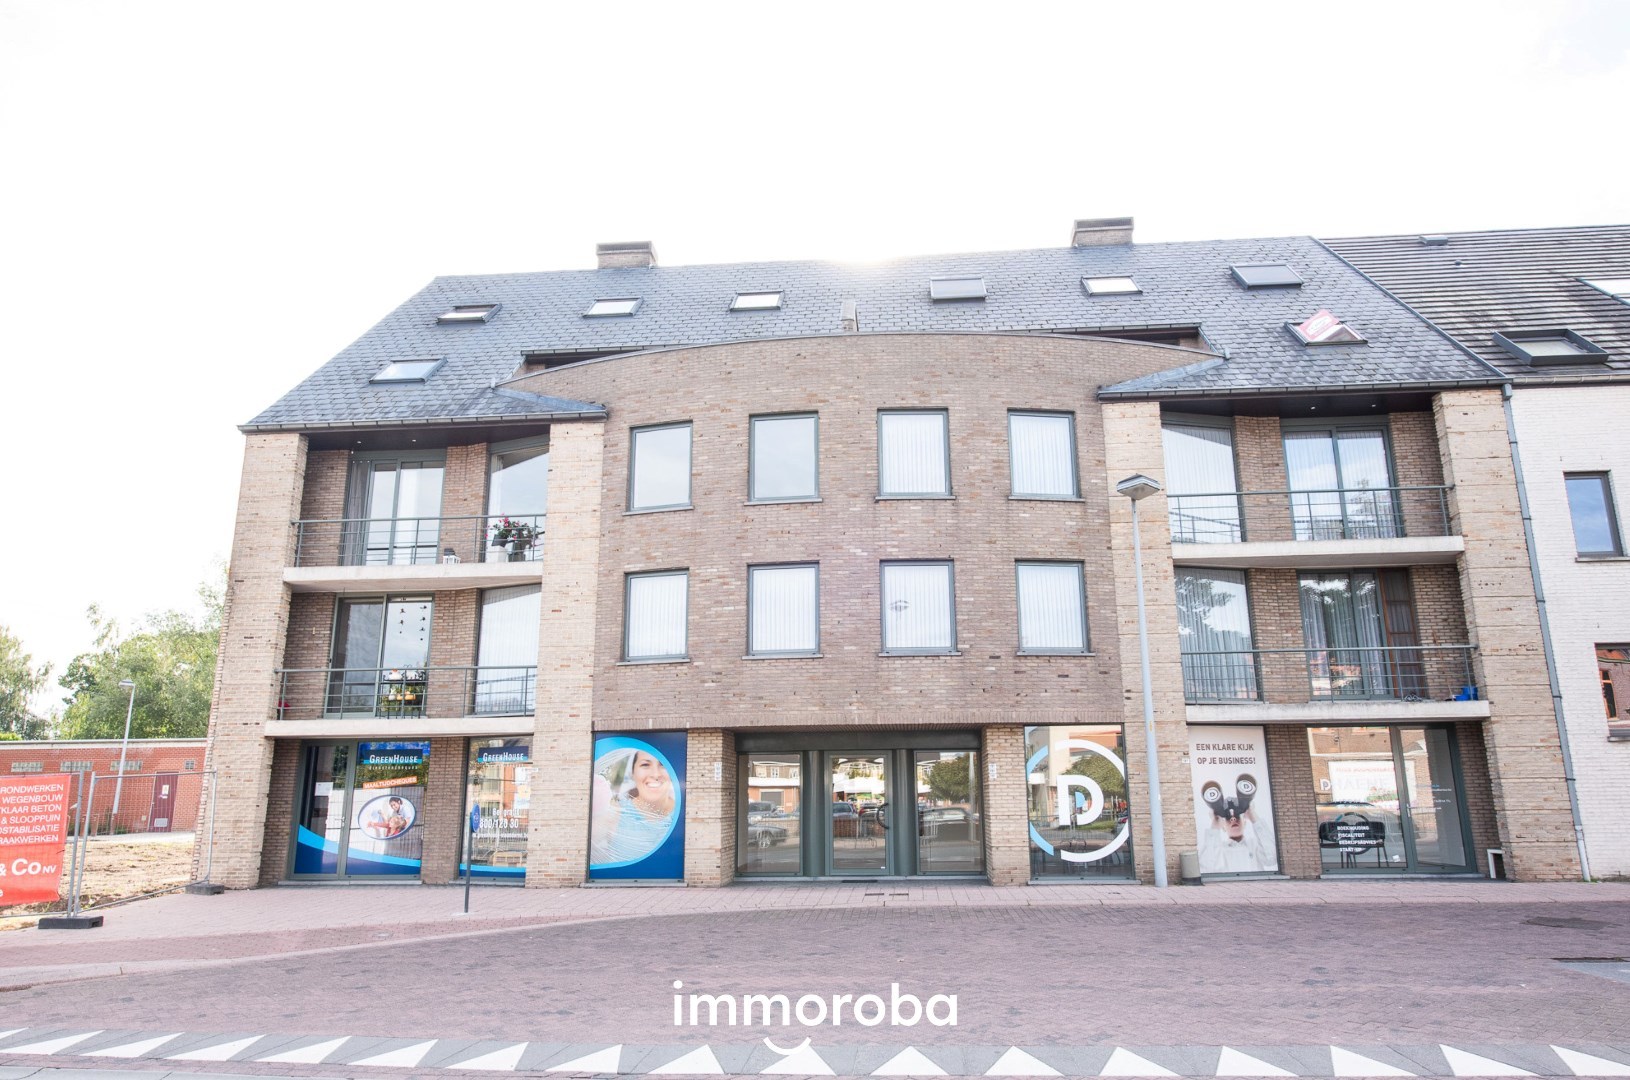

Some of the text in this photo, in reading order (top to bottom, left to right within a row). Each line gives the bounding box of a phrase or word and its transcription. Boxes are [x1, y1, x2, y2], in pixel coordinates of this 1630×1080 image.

[1196, 743, 1255, 751] EEN KLARE KIJK
[1197, 757, 1207, 765] OP
[1208, 757, 1218, 765] JE
[1218, 756, 1256, 765] BUSINESS!
[0, 784, 64, 794] RONDWERKEN
[2, 794, 63, 804] WEGENBOUW
[31, 804, 62, 813] BETON
[1, 814, 61, 824] & SLOOPPUIN
[11, 858, 42, 876] Co
[42, 865, 57, 874] NV
